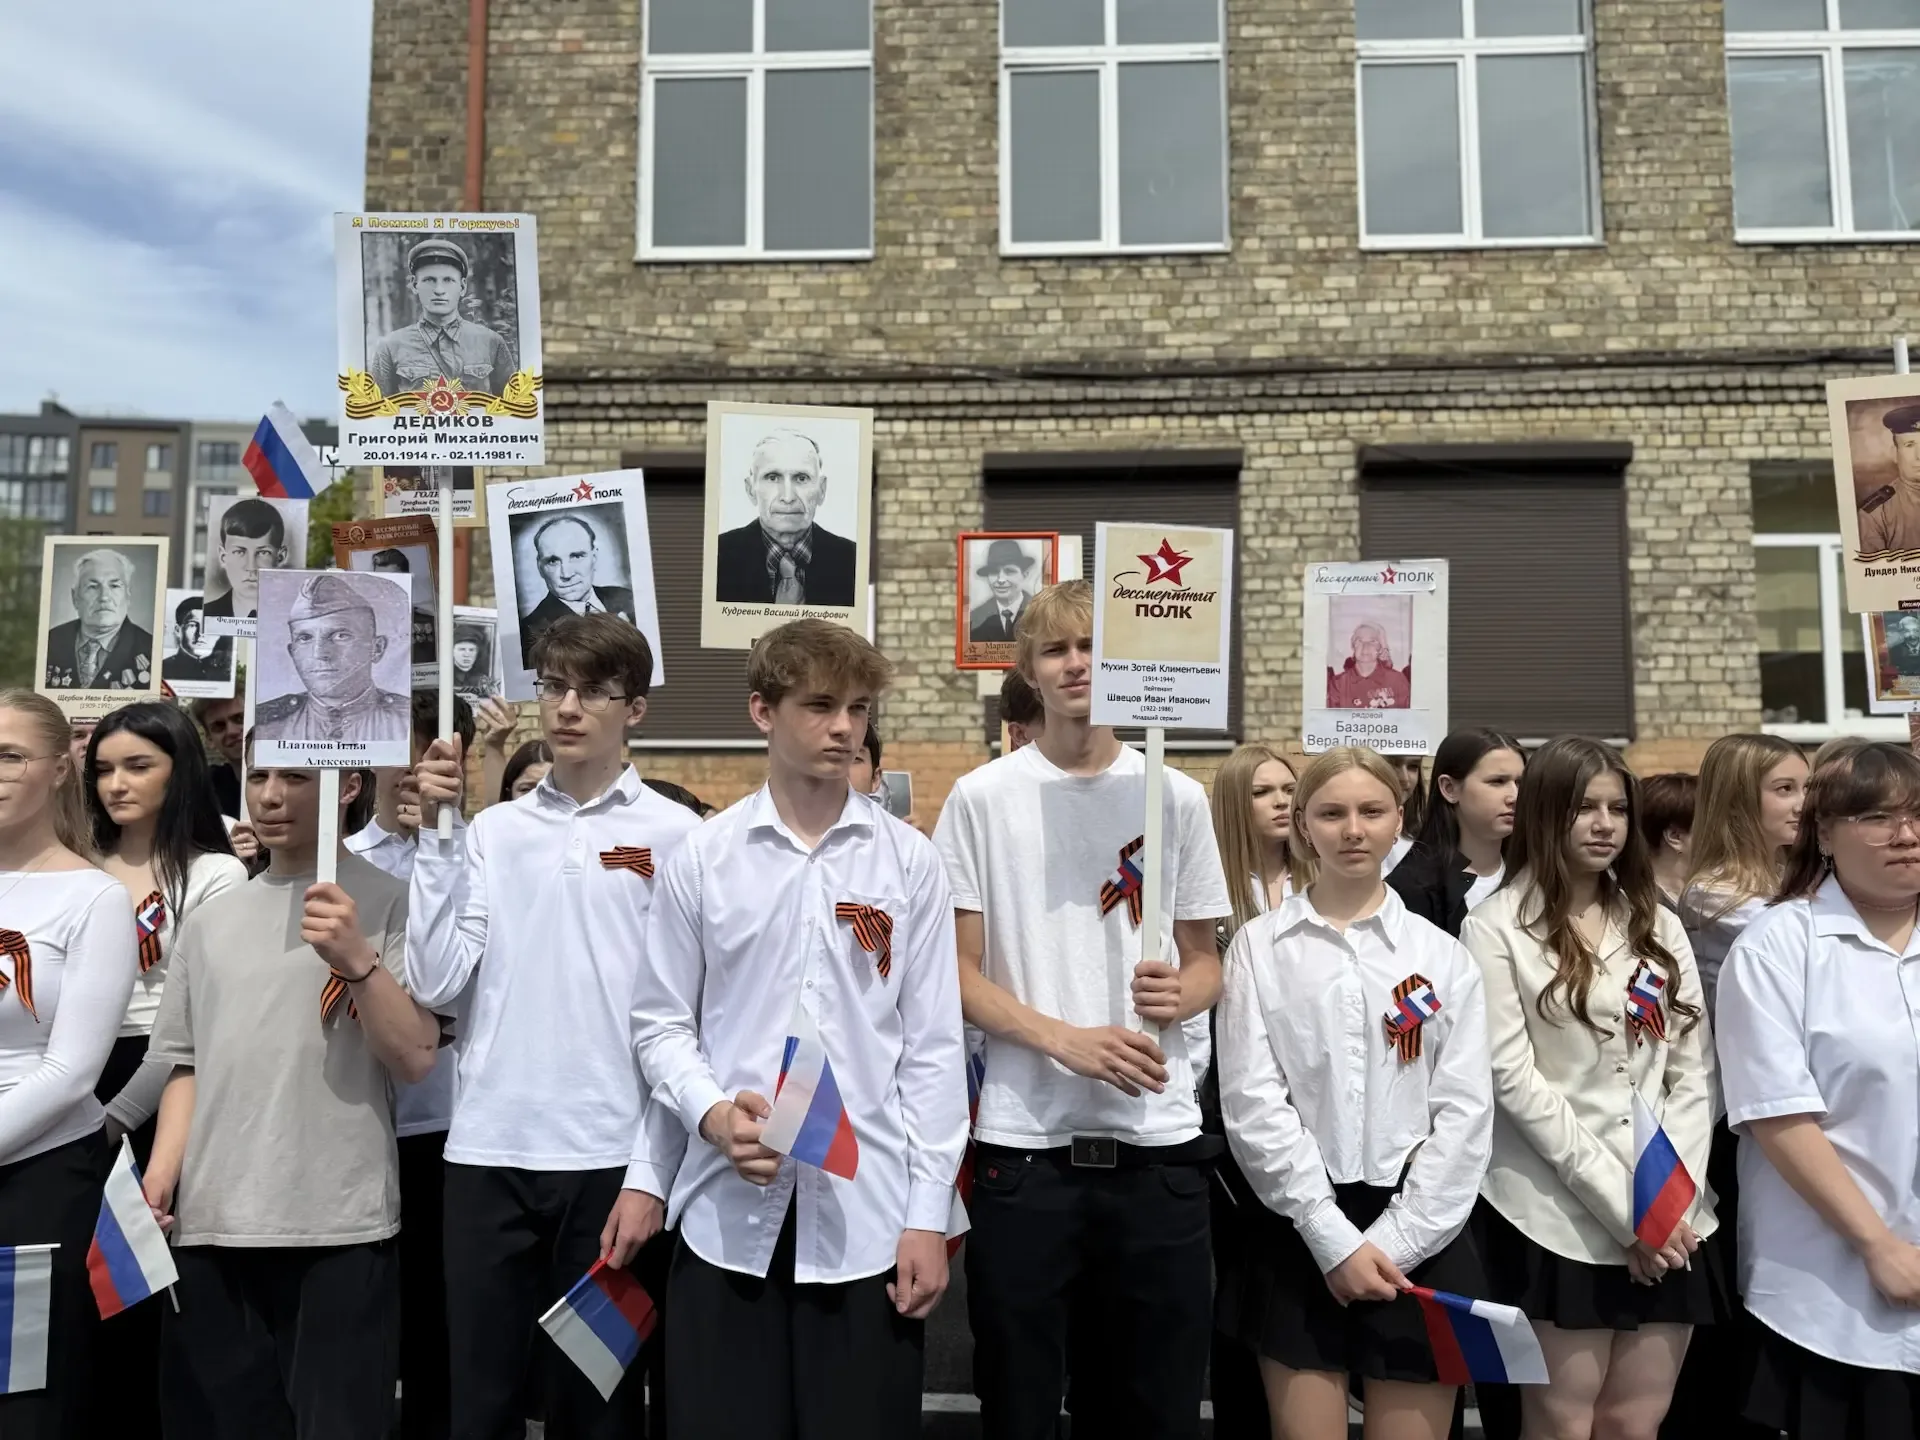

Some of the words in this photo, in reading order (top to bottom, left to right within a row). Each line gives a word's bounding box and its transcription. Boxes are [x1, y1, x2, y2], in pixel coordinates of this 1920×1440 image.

[352, 217, 363, 228] Я
[369, 217, 428, 228] Помню!
[434, 218, 444, 228] Я
[449, 218, 520, 230] Горжусь!
[393, 415, 494, 430] ДЕДИКОВ
[348, 433, 428, 445] Григорий
[434, 432, 539, 444] Михайлович
[363, 451, 428, 460] 20.01.1914
[449, 450, 512, 460] 02.11.1981
[507, 487, 575, 509] бессмертный
[594, 488, 623, 499] ПОЛК
[1864, 567, 1898, 577] Дундер
[1315, 566, 1380, 592] бессмертный
[1398, 571, 1435, 582] ПОЛК
[1113, 571, 1217, 603] бессмертный
[721, 606, 762, 617] Кудревич
[763, 608, 800, 617] Василий
[801, 609, 849, 619] Иосифович
[1135, 604, 1192, 619] ПОЛК
[1101, 662, 1129, 672] Мухин
[1131, 663, 1156, 672] Зотей
[1159, 664, 1221, 674] Климентьевич
[1107, 692, 1141, 703] Швецов
[1144, 694, 1166, 703] Иван
[1168, 695, 1211, 704] Иванович
[1335, 720, 1398, 735] Базарова
[277, 740, 333, 750] Платонов
[1307, 734, 1339, 748] Вера
[1344, 735, 1427, 750] Григорьевна
[304, 757, 371, 766] Алексеевич
